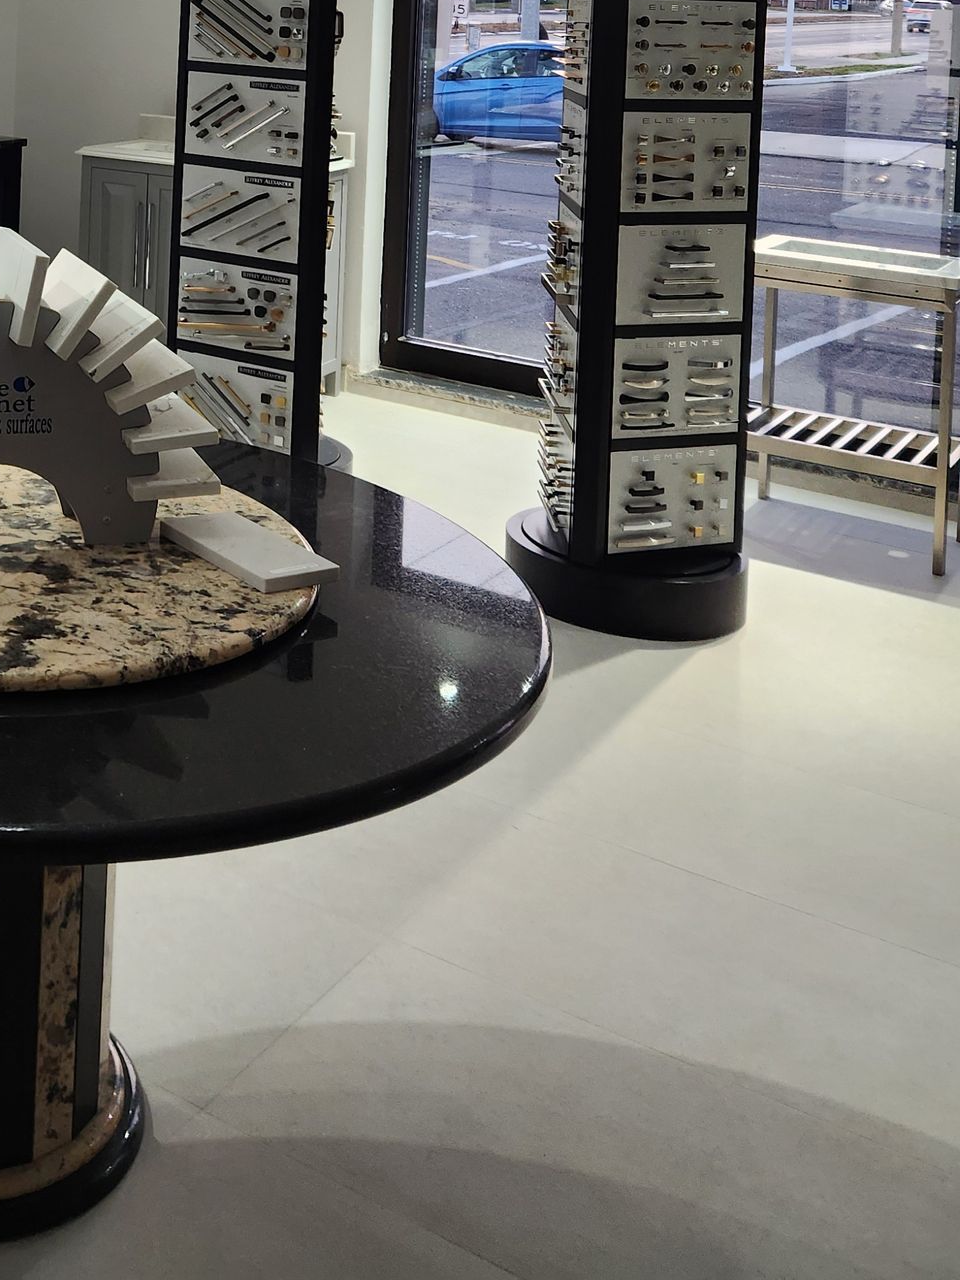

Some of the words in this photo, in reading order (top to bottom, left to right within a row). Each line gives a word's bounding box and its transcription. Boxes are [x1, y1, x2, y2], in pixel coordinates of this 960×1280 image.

[635, 339, 721, 350] ELEMENTS
[6, 413, 53, 434] surfaces
[631, 448, 718, 463] ELEMENTS
